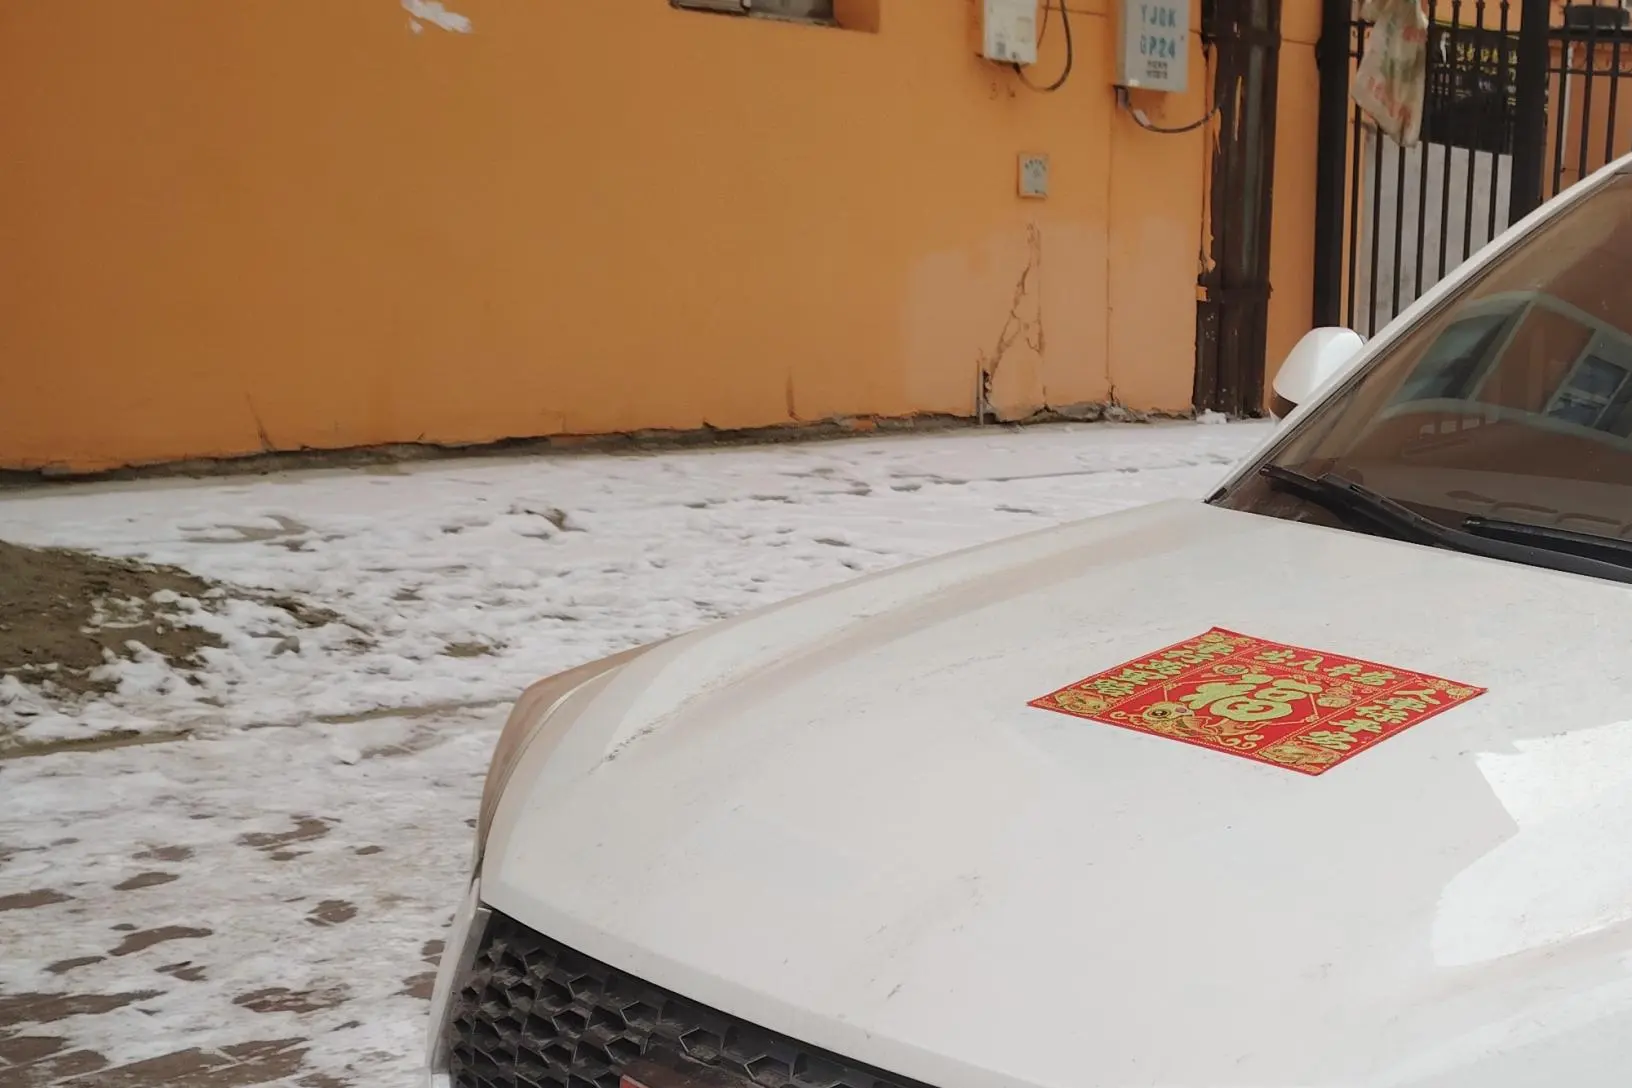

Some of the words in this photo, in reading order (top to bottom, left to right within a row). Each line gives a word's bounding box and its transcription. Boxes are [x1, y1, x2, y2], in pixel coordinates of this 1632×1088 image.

[1254, 648, 1397, 686] 出入平安
[1179, 673, 1324, 722] 福
